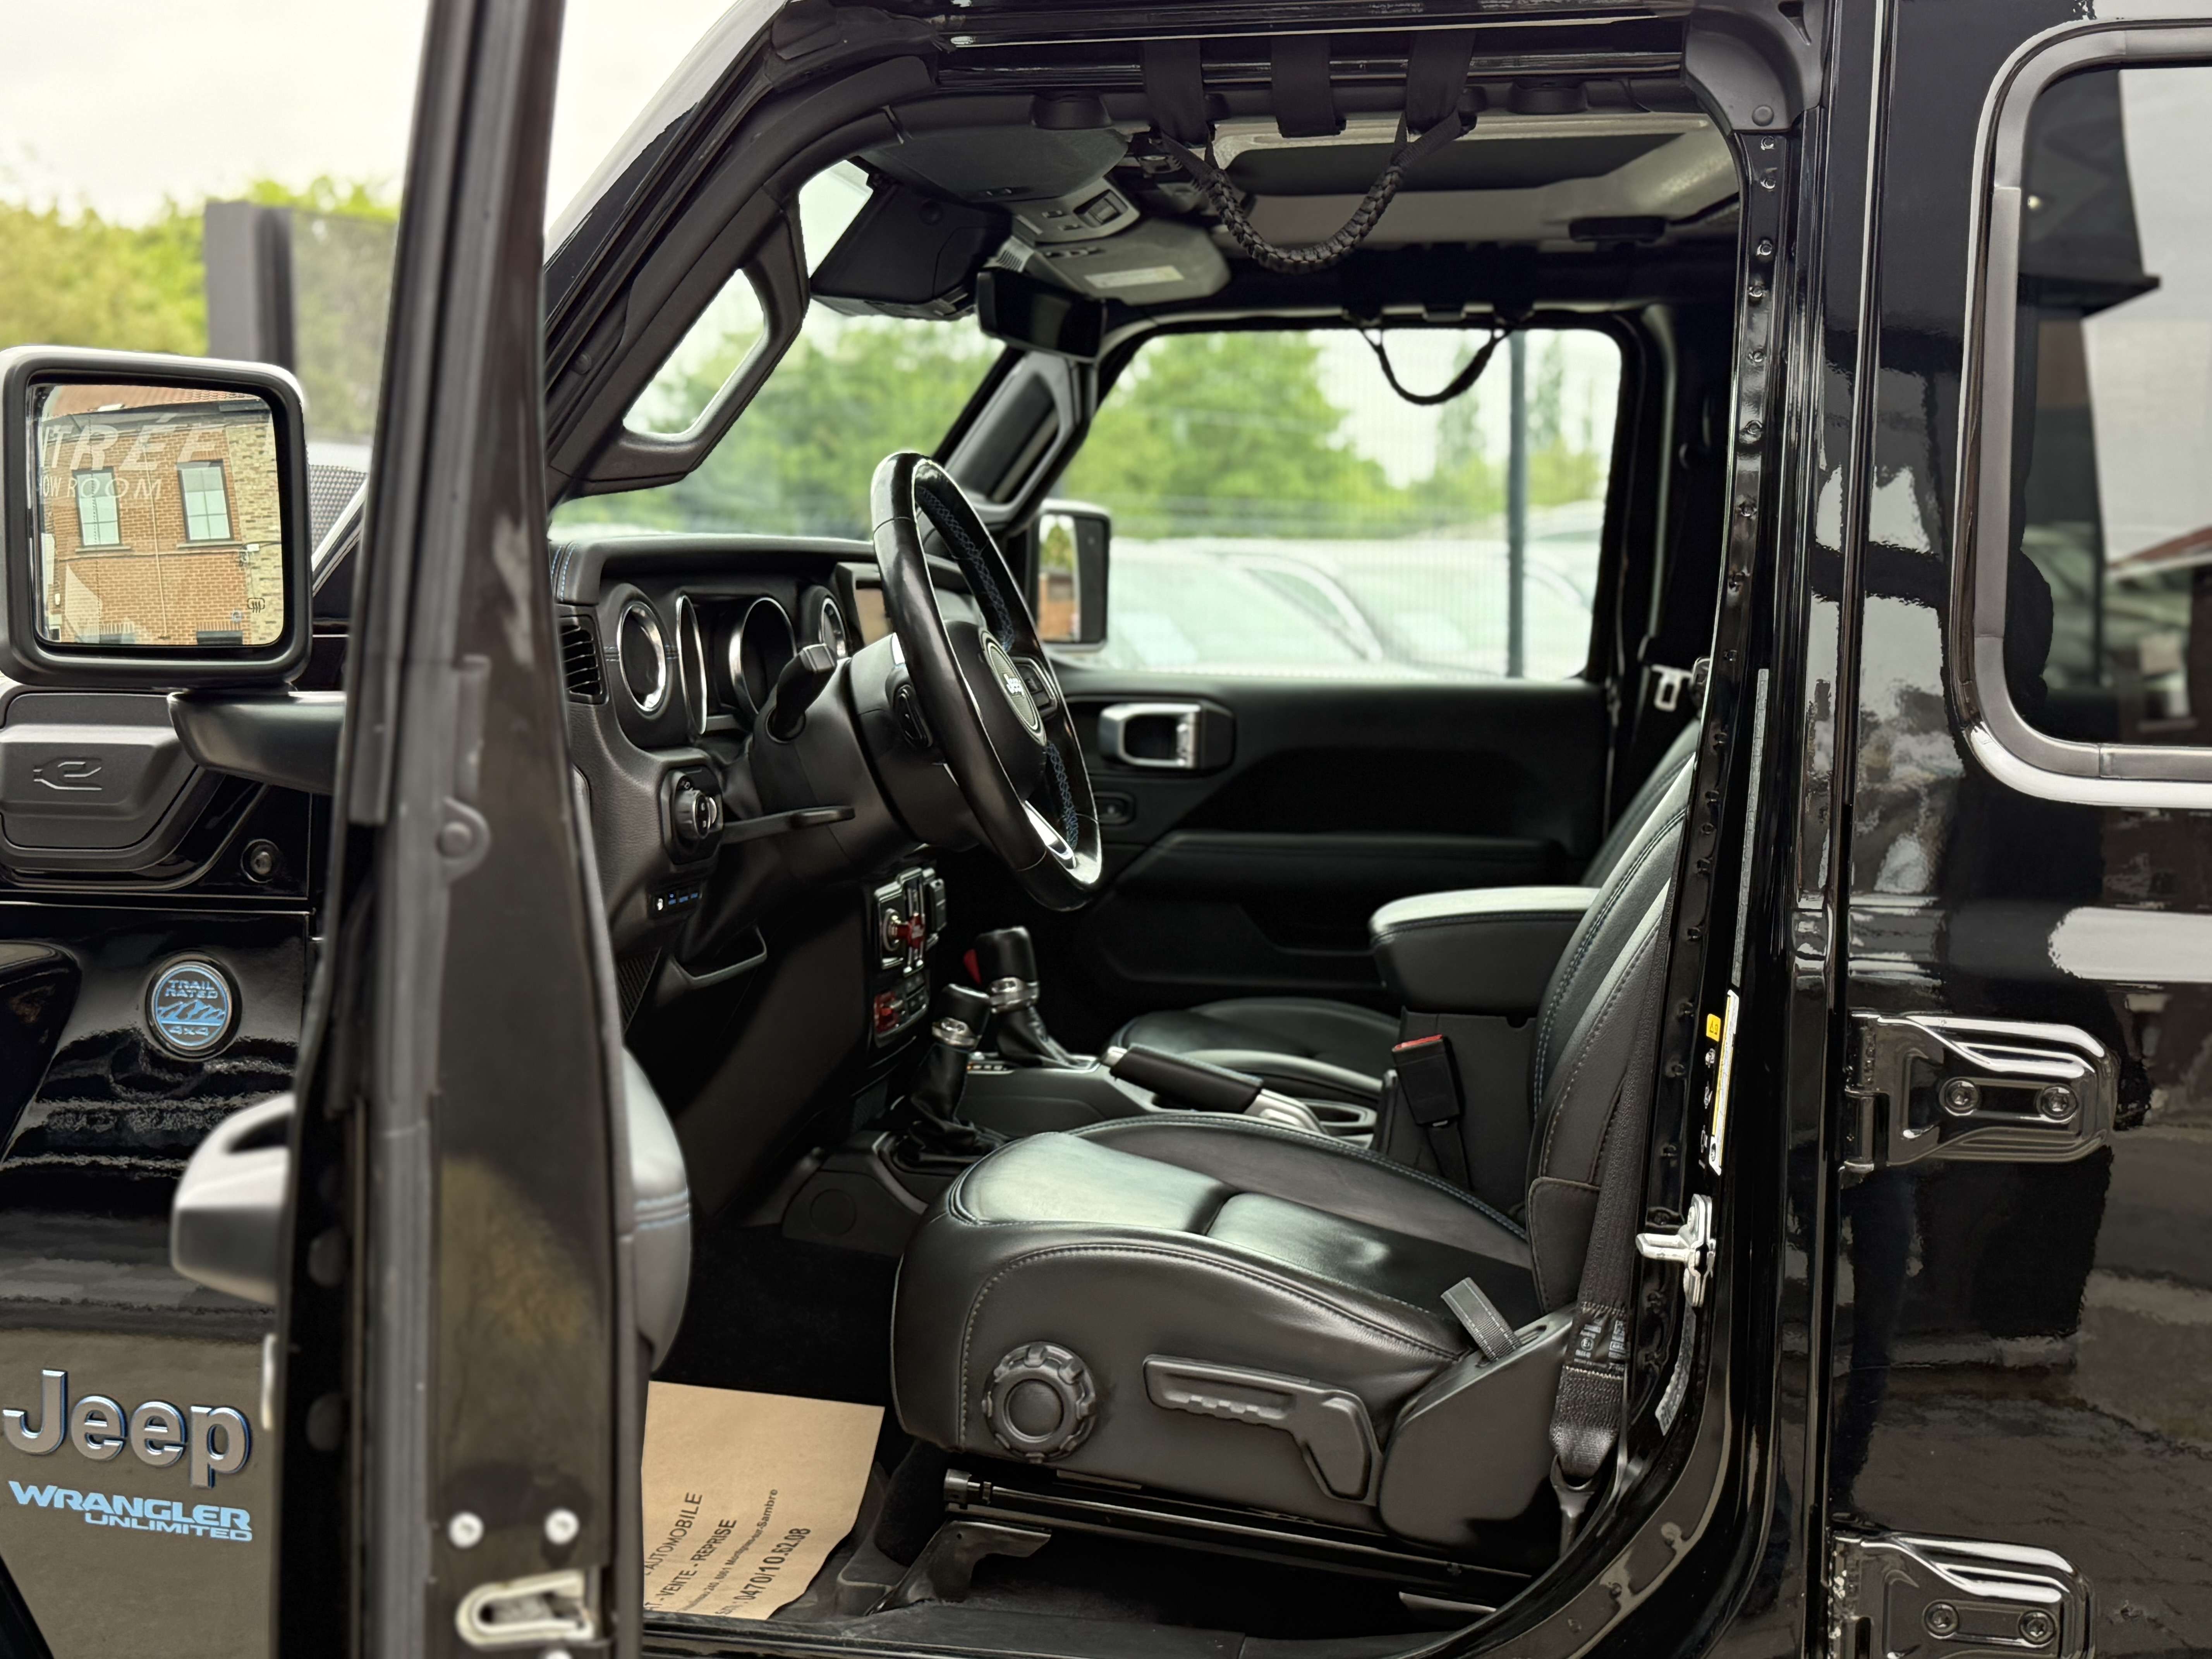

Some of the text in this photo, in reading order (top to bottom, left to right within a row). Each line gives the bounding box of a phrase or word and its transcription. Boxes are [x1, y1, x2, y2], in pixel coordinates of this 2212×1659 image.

[165, 988, 218, 999] RATED
[168, 980, 215, 990] TRAIL
[2, 1368, 252, 1488] Jeep
[8, 1480, 252, 1531] WRANGLER
[84, 1512, 253, 1542] UNLIMITED
[655, 1570, 698, 1596] VENTE
[690, 1519, 737, 1561] REPRISE
